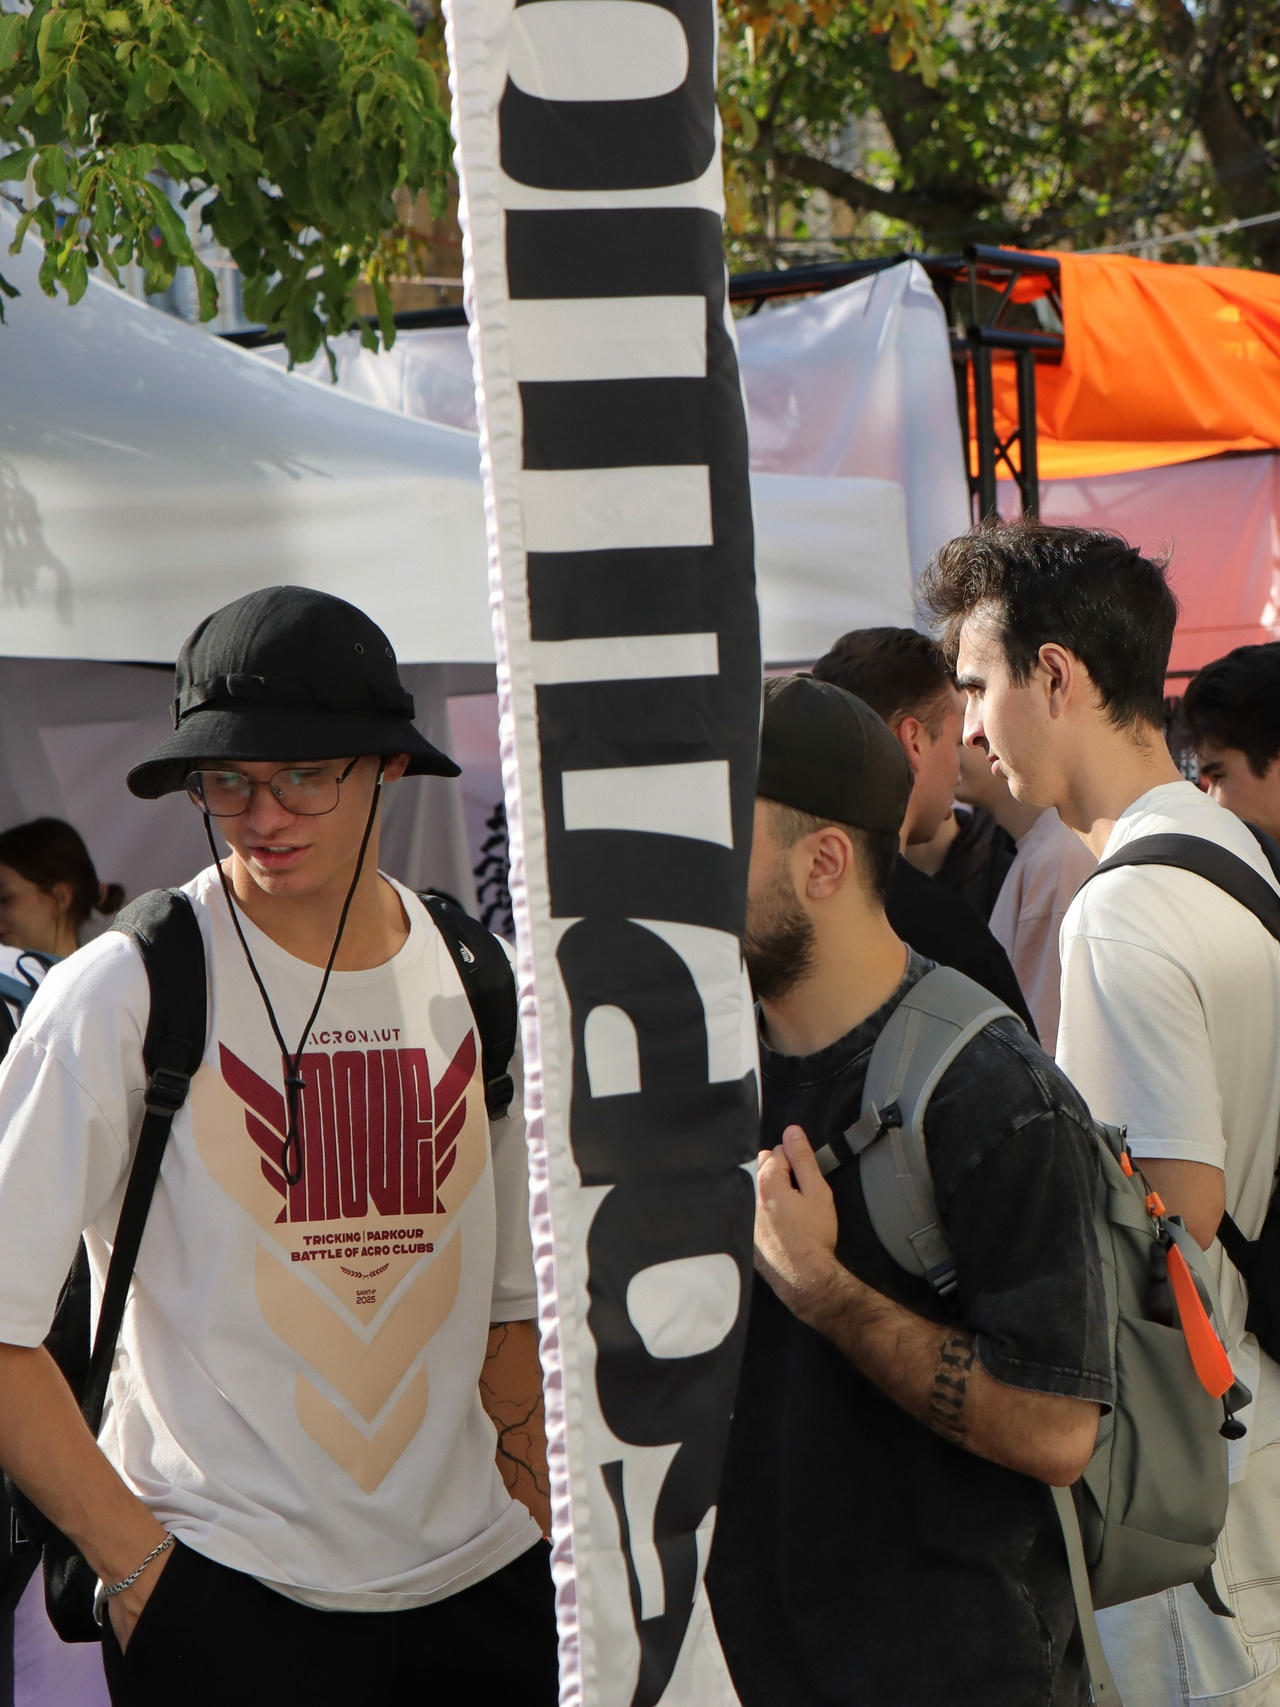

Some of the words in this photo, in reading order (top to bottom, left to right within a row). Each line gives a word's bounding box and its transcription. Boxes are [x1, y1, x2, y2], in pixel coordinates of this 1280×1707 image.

[309, 1028, 401, 1045] ACRONAUT
[302, 1231, 362, 1246] TRICKING
[366, 1228, 424, 1242] PARKOUR
[290, 1249, 343, 1263] BATTLE
[344, 1247, 359, 1259] OF
[361, 1244, 391, 1257] ACRO
[392, 1242, 435, 1255] CLUBS
[355, 1295, 376, 1305] 2025
